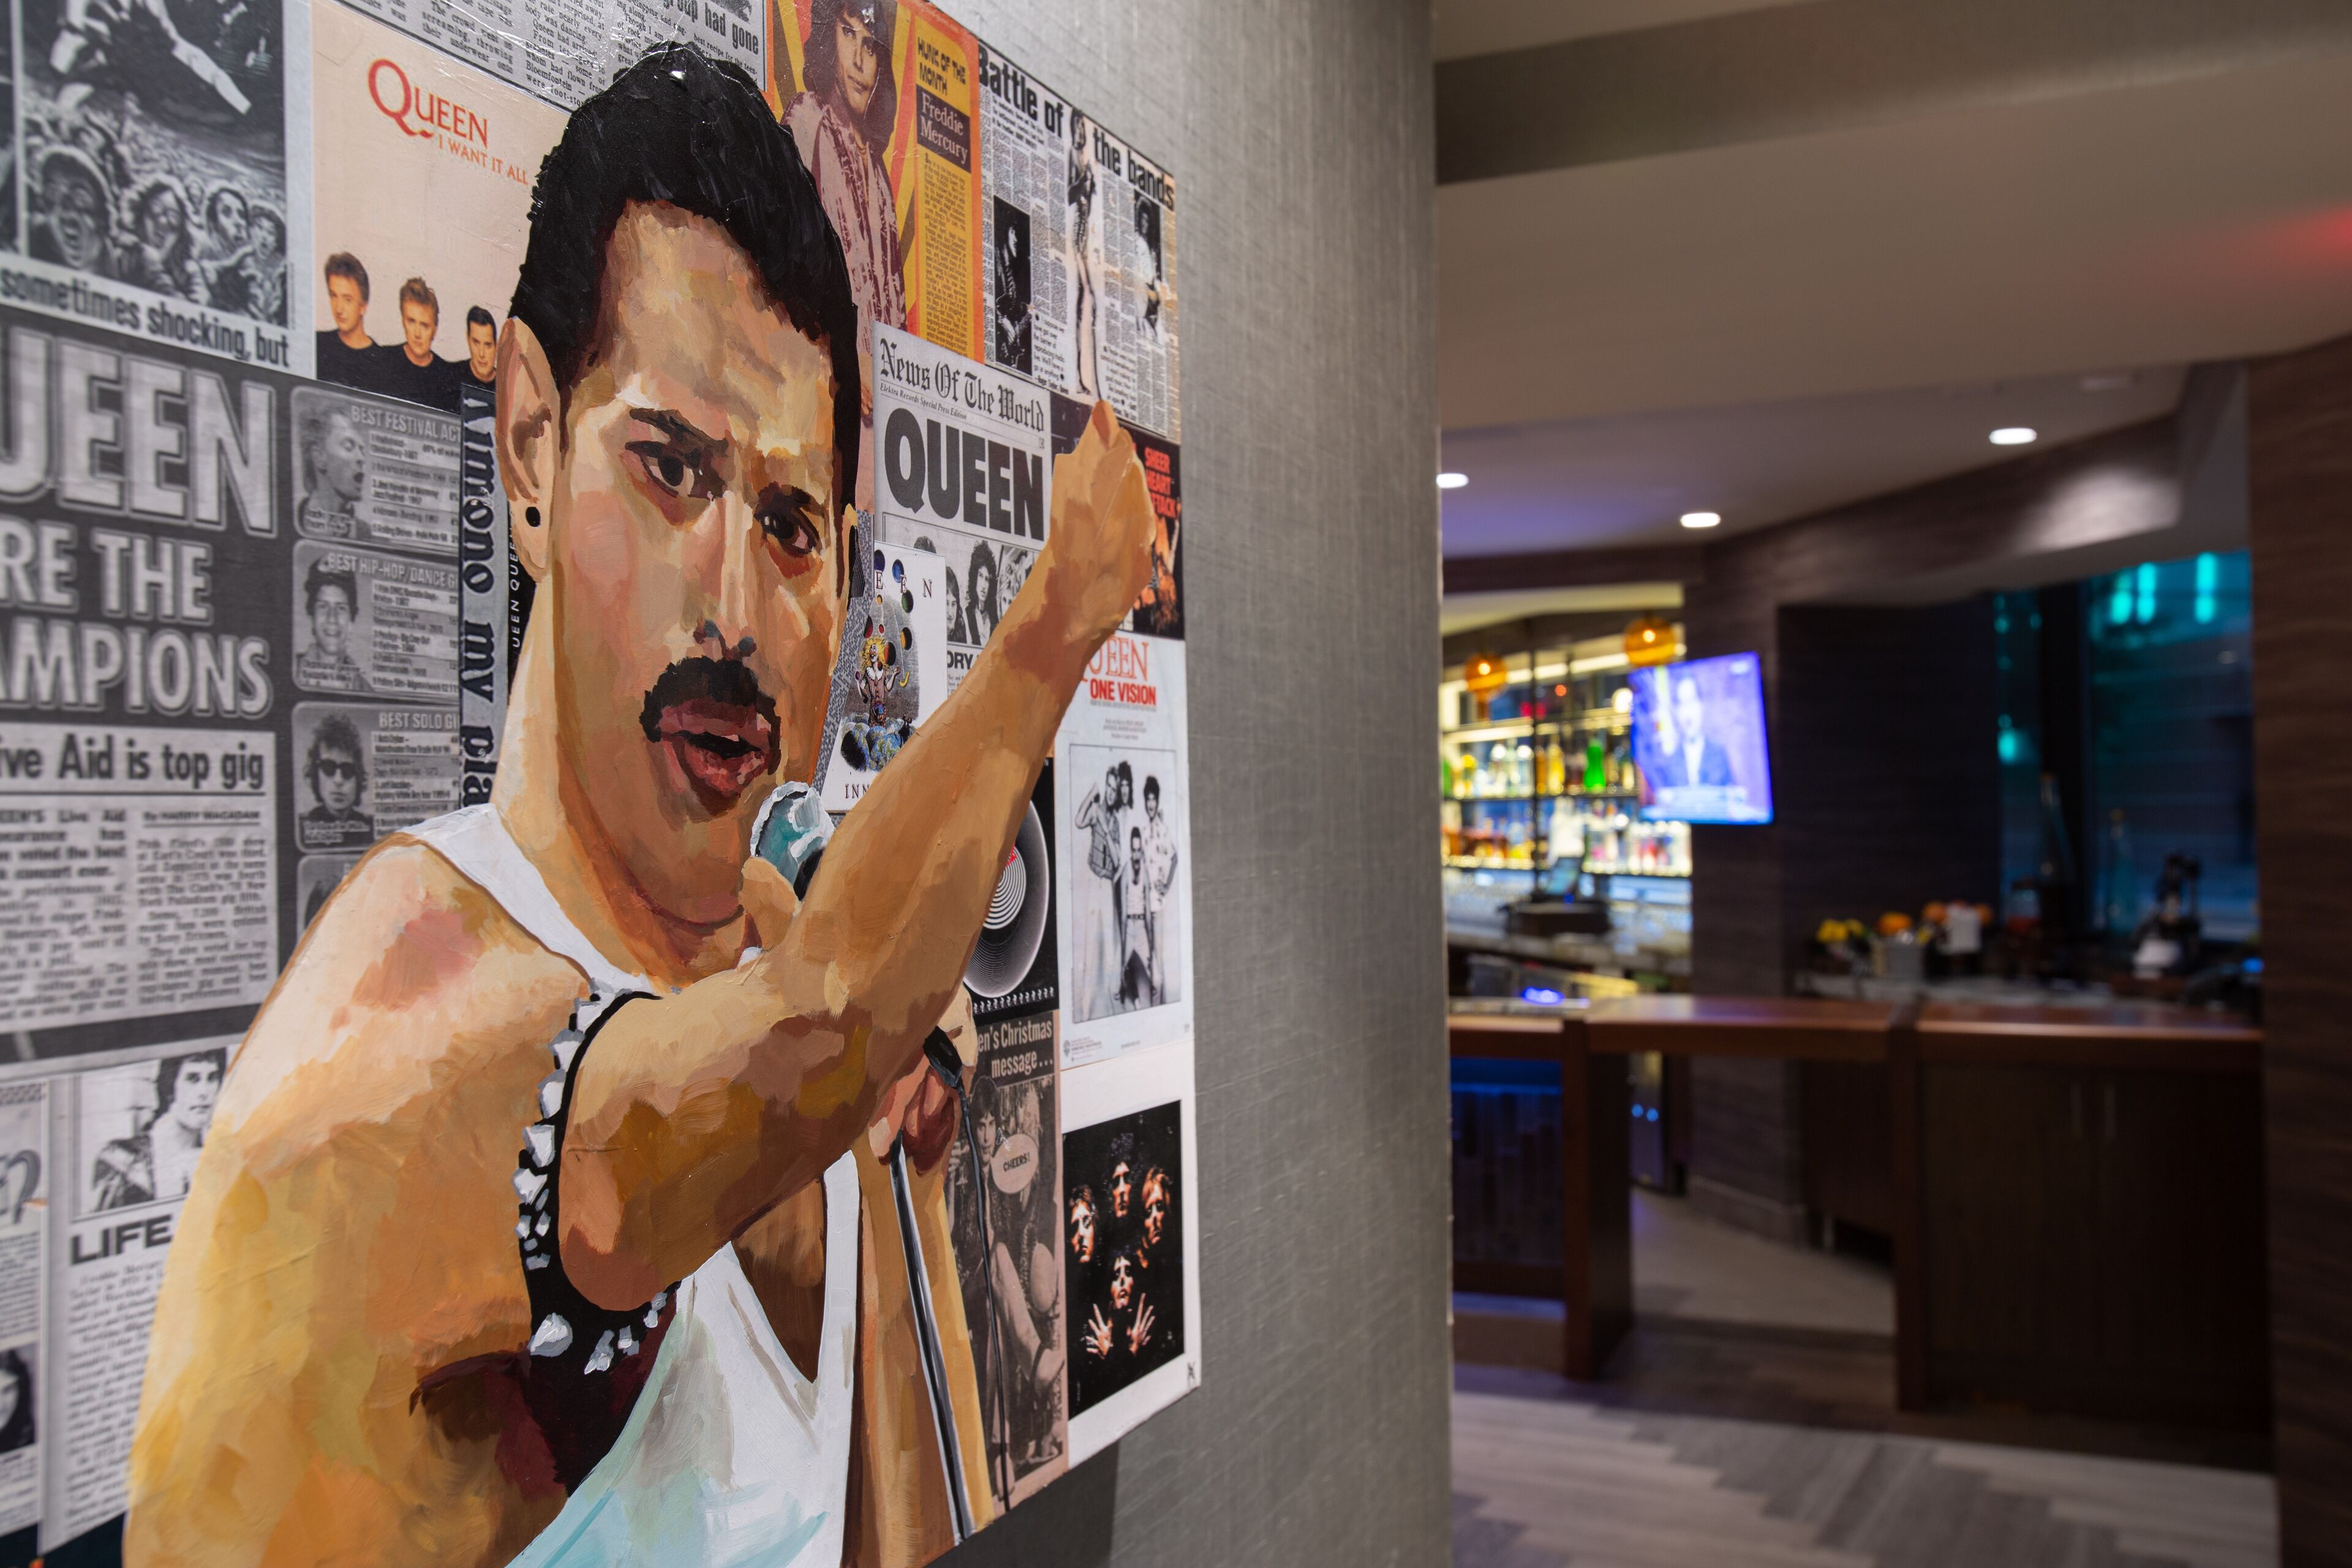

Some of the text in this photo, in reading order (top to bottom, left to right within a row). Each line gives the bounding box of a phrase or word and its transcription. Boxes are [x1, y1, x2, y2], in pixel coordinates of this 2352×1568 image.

[525, 2, 587, 45] body was dancing.
[533, 18, 554, 37] Queen
[557, 31, 569, 45] had
[559, 12, 580, 29] nearly
[584, 26, 602, 41] every
[624, 13, 646, 31] Though
[654, 31, 664, 41] am
[629, 7, 647, 23] along.
[705, 2, 726, 37] had
[731, 23, 759, 55] gone
[450, 37, 490, 62] underwear
[533, 29, 554, 48] From
[618, 42, 633, 55] what
[628, 27, 641, 39] rock
[694, 33, 706, 46] best
[707, 42, 724, 58] recipe
[477, 38, 513, 64] throwing
[526, 50, 546, 67] whom
[551, 62, 563, 75] had
[568, 70, 585, 86] flown
[918, 37, 966, 85] HUNK OF THE
[526, 60, 572, 91] Bloemfontein
[576, 66, 592, 78] some
[919, 62, 948, 96] MONTH
[368, 58, 488, 149] QUEEN
[526, 74, 584, 107] were foot-sto
[922, 91, 964, 136] Freddie
[978, 43, 1038, 121] Battle
[1044, 100, 1063, 138] of
[1093, 126, 1121, 176] the
[1128, 148, 1174, 212] bands
[921, 115, 968, 165] Mercury
[439, 134, 529, 185] I WANT IT ALL
[0, 265, 290, 368] sometimes shocking, but
[880, 338, 1044, 432] News Of The World
[880, 383, 967, 420] Elektra Records Special Press Edition
[351, 404, 384, 426] BEST
[385, 412, 439, 437] FESTIVAL
[884, 407, 1044, 541] QUEEN
[91, 527, 214, 625] THE
[328, 552, 357, 571] BEST
[509, 528, 521, 649] UEEN QUEE
[461, 620, 495, 703] my
[1082, 635, 1149, 682] UEEN
[1090, 678, 1115, 701] ONE
[1117, 682, 1156, 706] VISION
[379, 712, 410, 729] BEST
[413, 714, 442, 729] SOLO
[58, 734, 114, 780] Aid
[127, 737, 150, 781] is
[162, 745, 210, 790] top
[221, 742, 265, 790] gig
[978, 1019, 1053, 1053] en's Christmas
[1003, 1152, 1030, 1172] CHEERS!
[69, 1213, 174, 1265] LIFE
